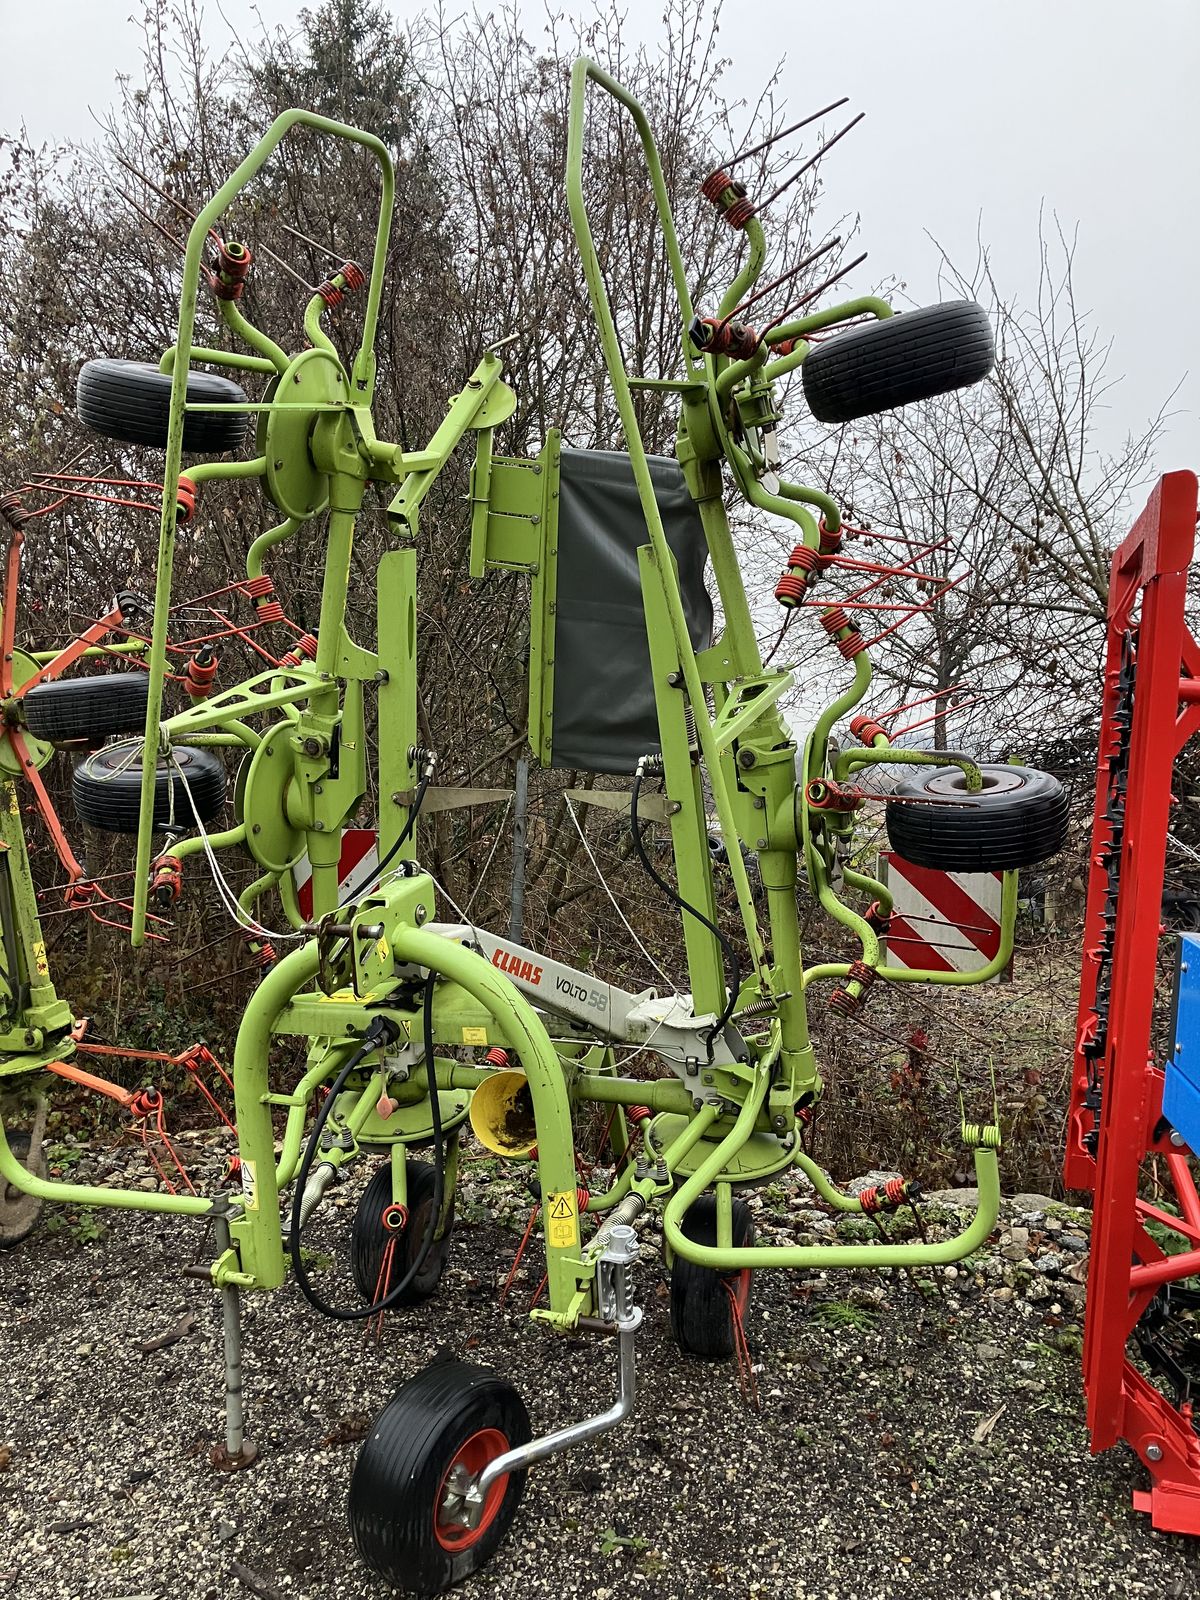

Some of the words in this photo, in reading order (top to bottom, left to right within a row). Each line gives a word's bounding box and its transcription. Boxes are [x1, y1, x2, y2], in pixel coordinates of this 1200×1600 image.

[492, 948, 543, 985] CLAAS
[556, 976, 588, 1002] VOLTO
[588, 989, 609, 1012] 58
